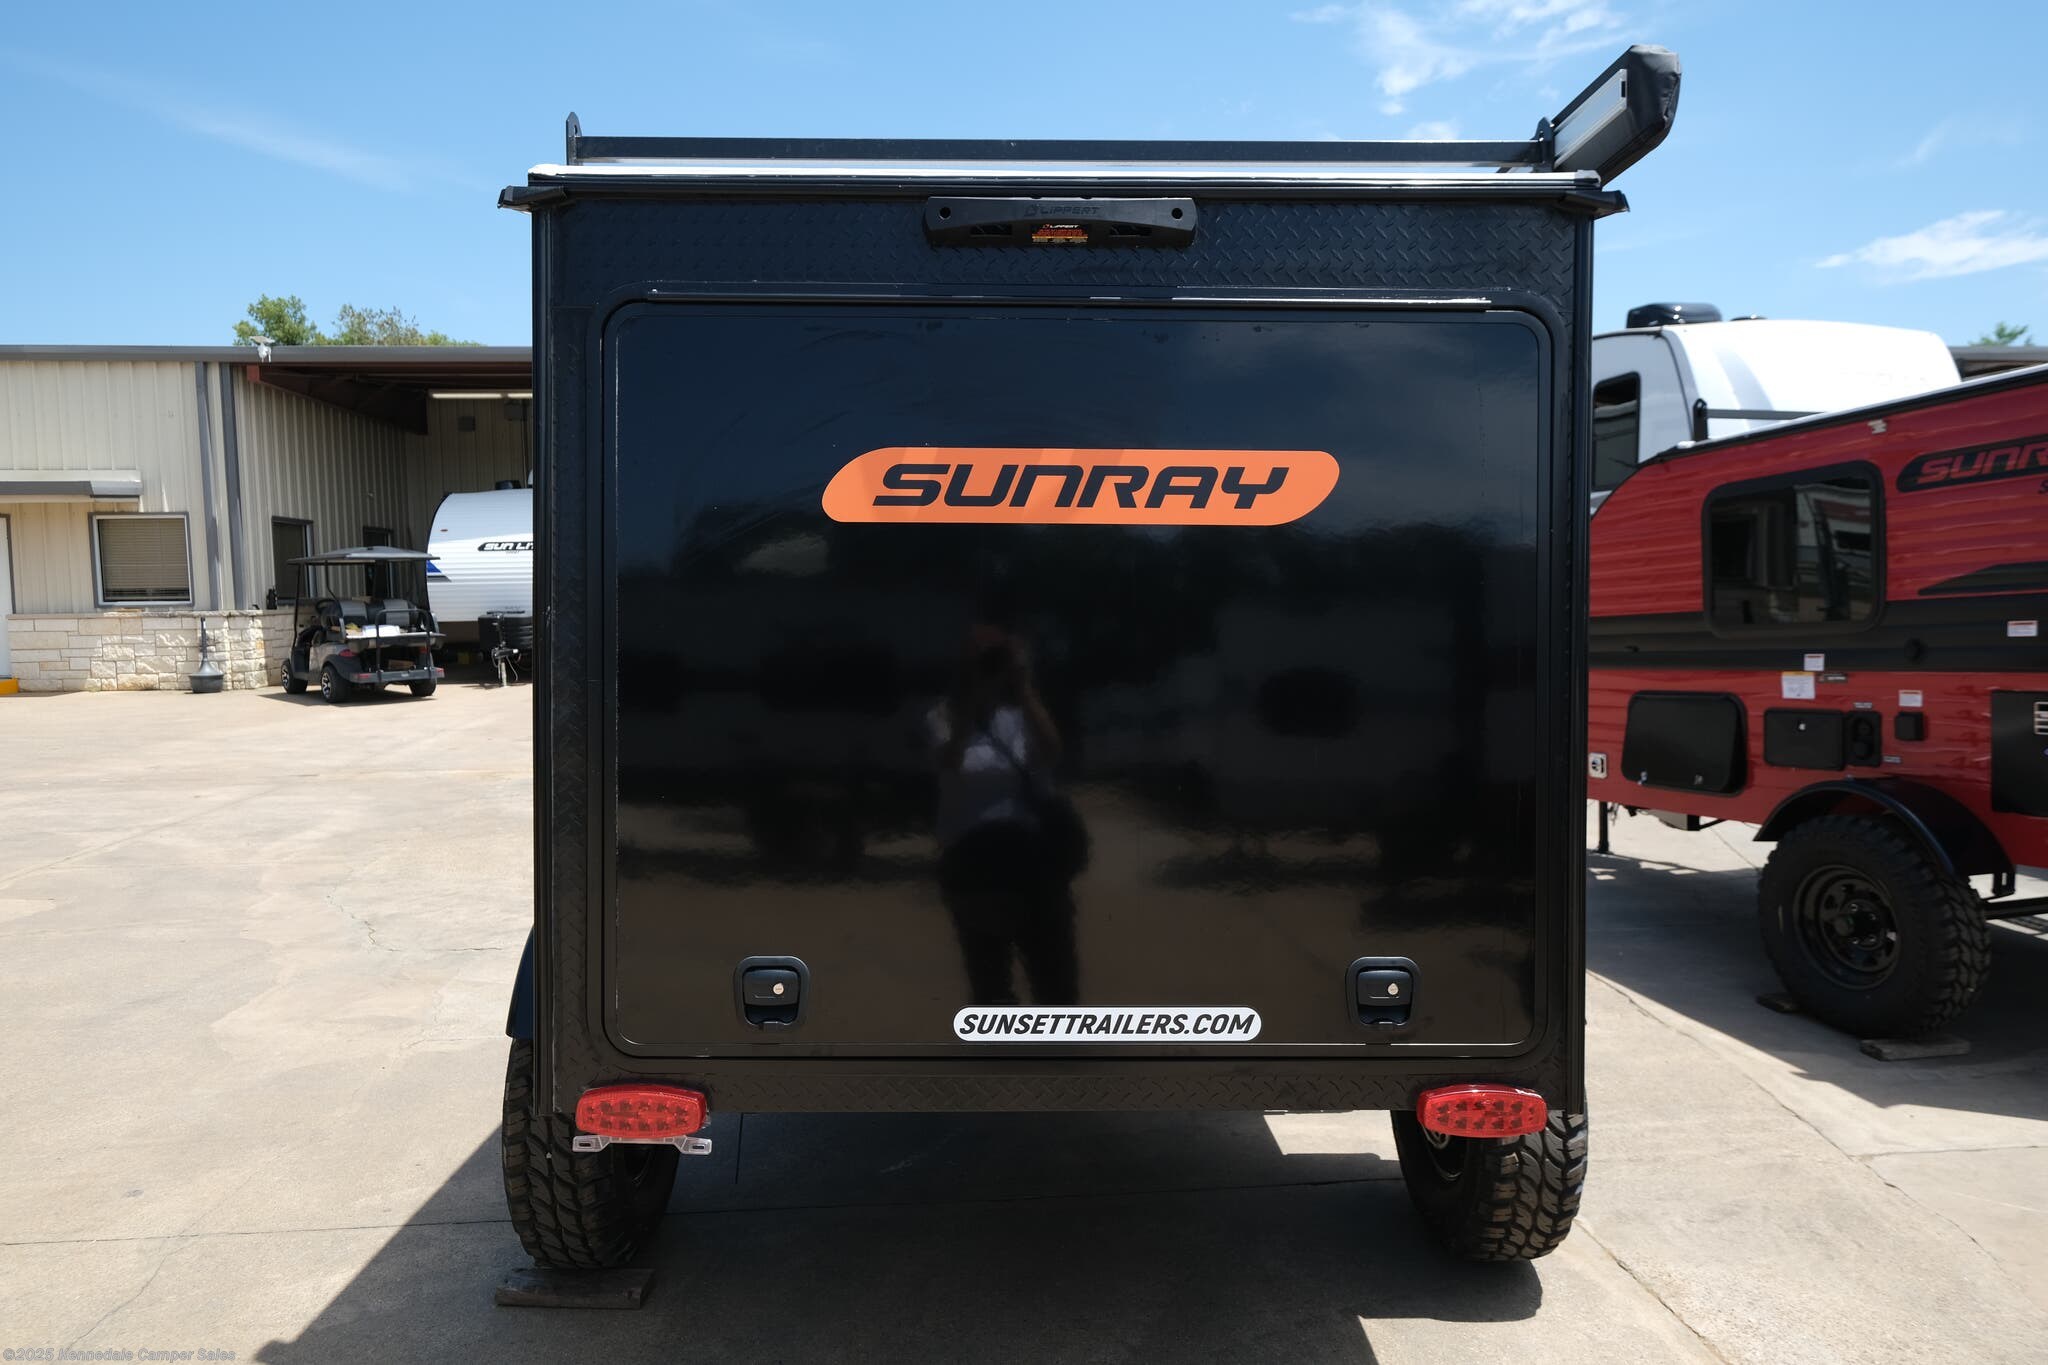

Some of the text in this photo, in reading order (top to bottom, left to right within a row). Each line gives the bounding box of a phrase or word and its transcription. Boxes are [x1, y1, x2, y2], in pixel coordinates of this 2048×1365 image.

[1040, 206, 1099, 214] LIPPERT
[872, 463, 1289, 509] SUNRAY
[484, 542, 514, 550] SUN
[959, 1013, 1256, 1035] SUNSETTRAILERS.COM
